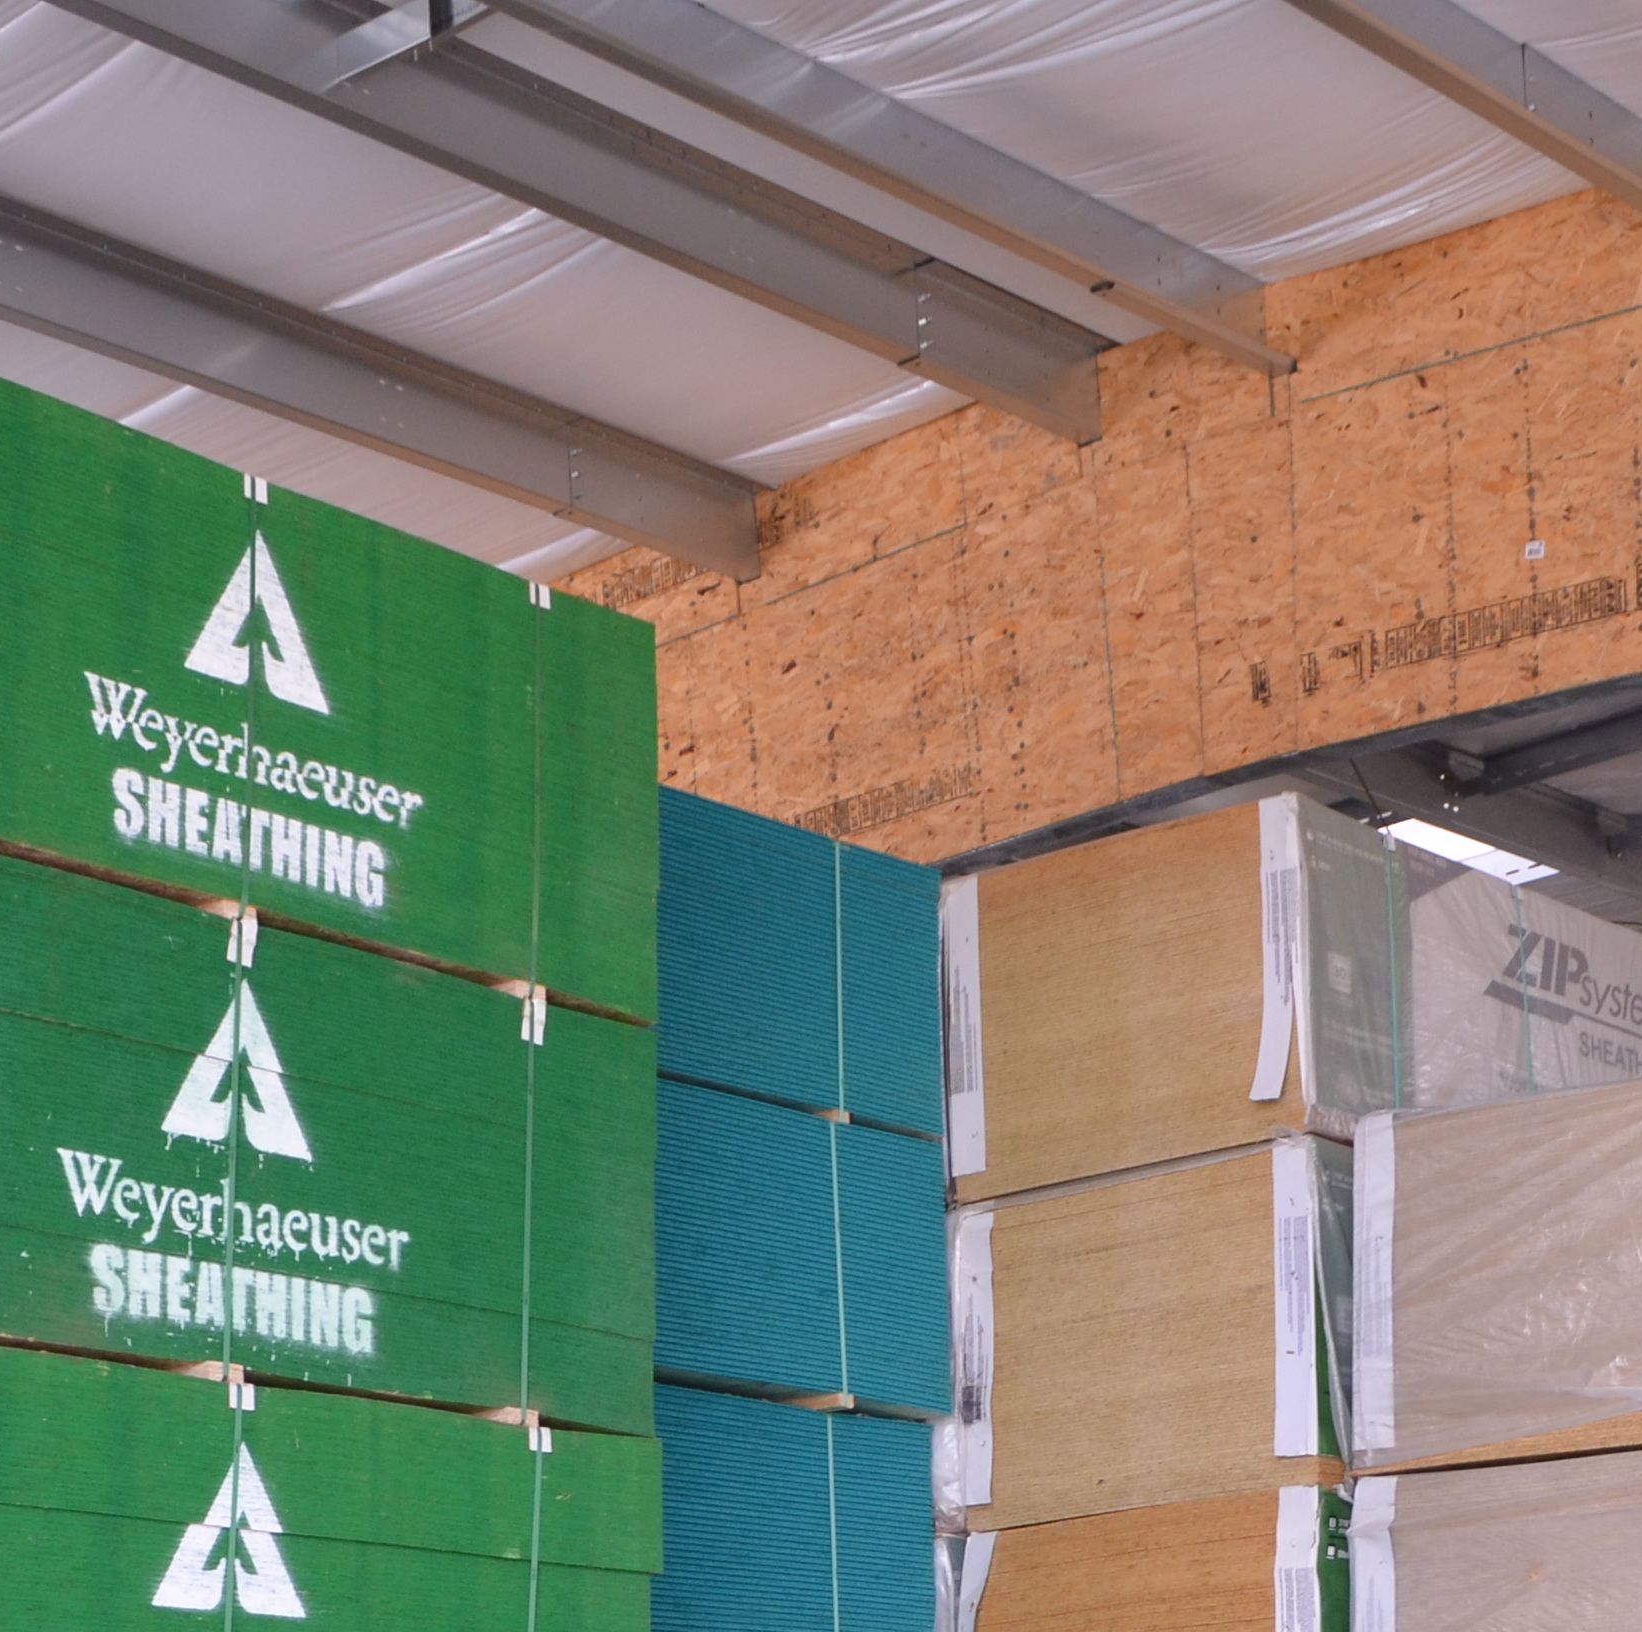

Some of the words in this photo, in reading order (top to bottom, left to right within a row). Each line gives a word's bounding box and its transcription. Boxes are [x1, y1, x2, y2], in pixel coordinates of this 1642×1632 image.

[84, 671, 424, 830] Weyerhaeuser
[112, 768, 387, 908] SHEATHING
[58, 1148, 409, 1272] Weyerhaeuser
[92, 1242, 372, 1353] SHEATHING
